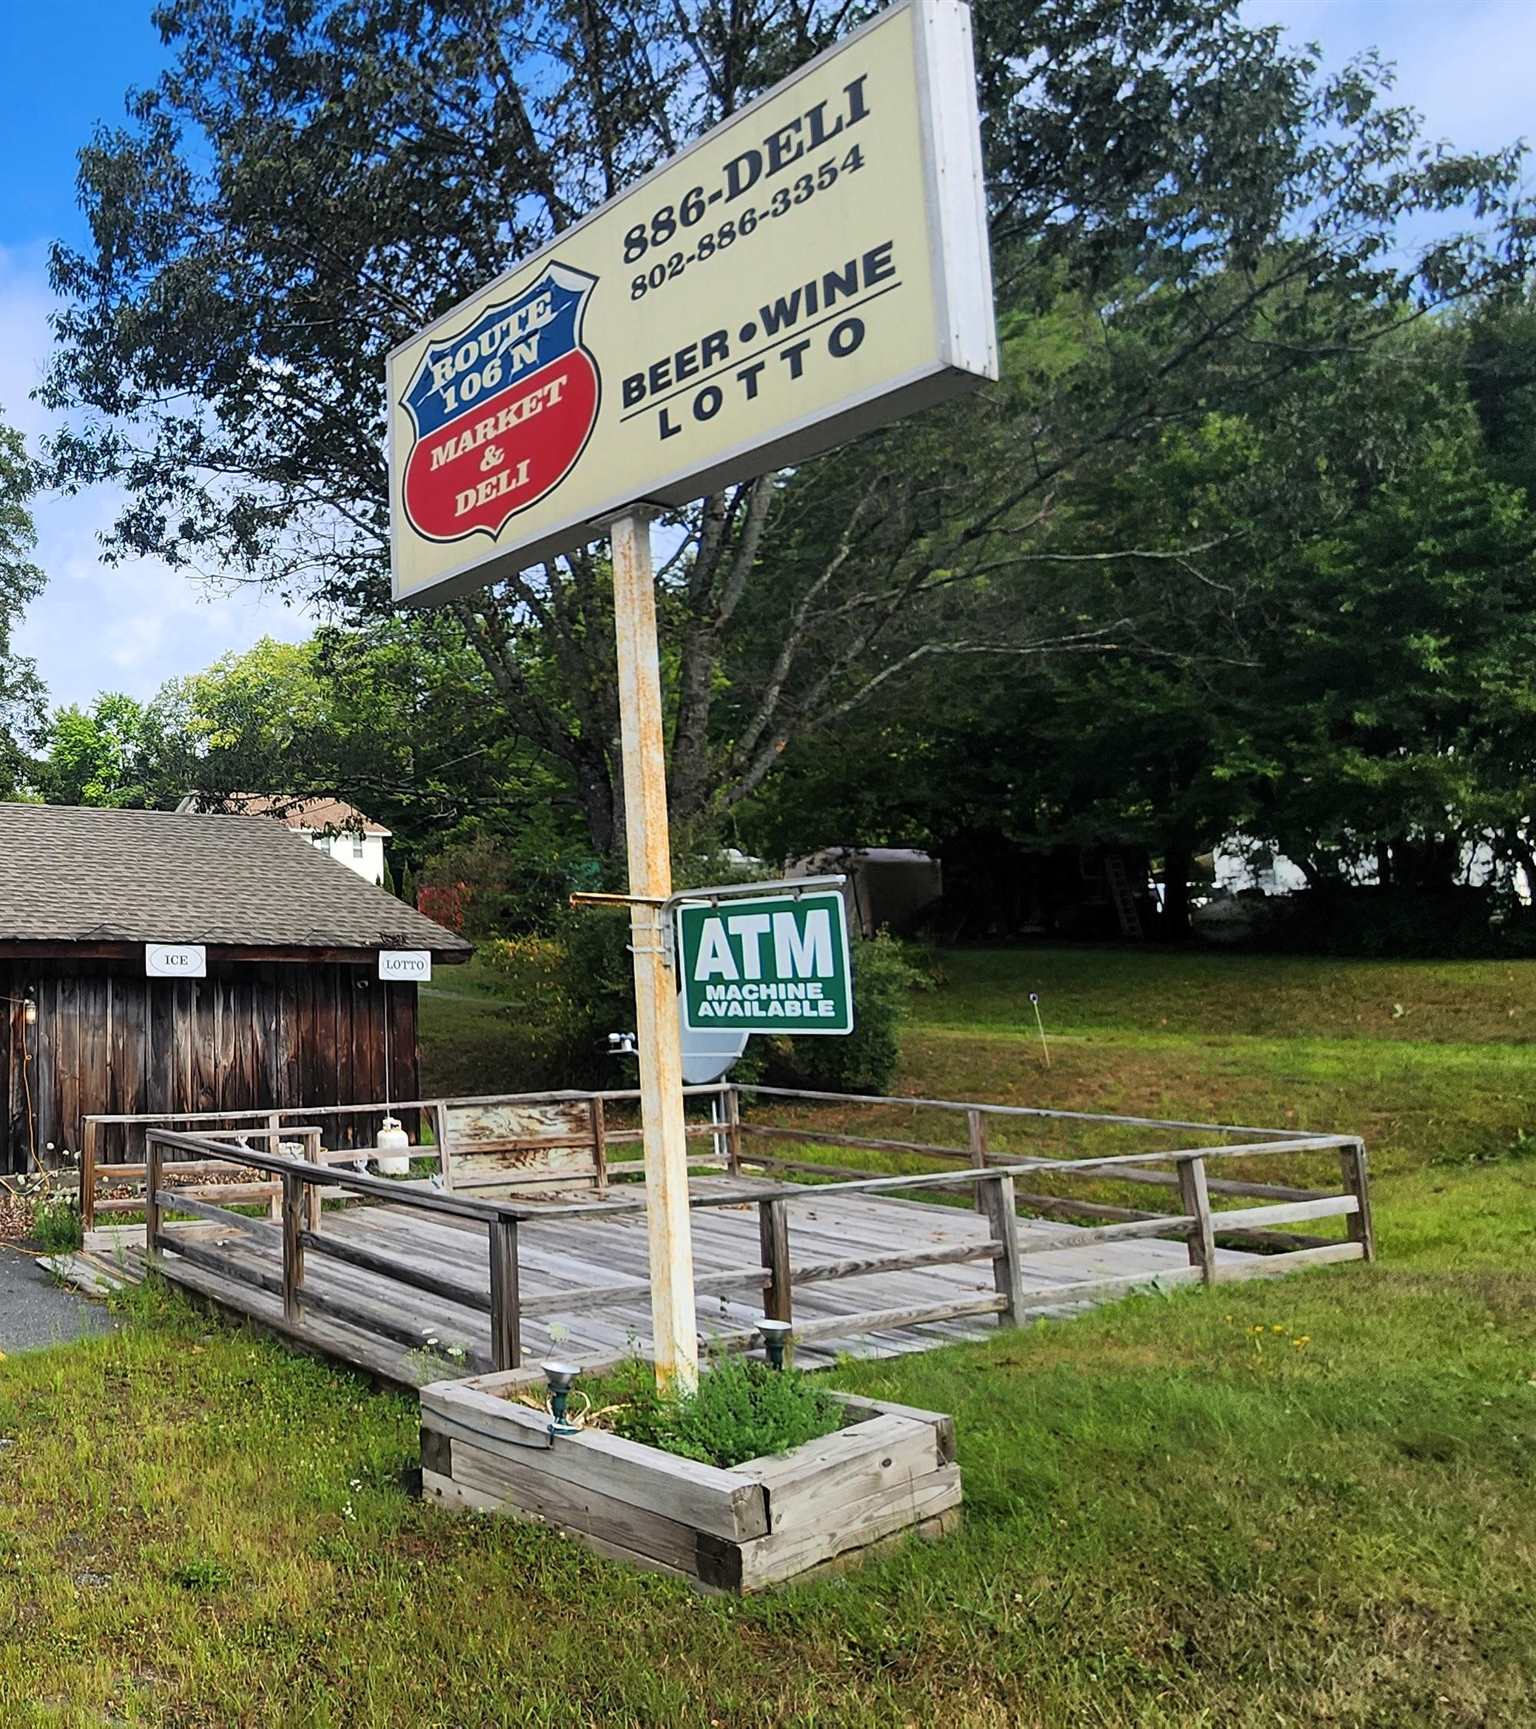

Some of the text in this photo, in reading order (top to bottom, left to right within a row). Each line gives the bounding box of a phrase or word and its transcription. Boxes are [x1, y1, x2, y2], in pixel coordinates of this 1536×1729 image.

[623, 73, 871, 264] 886-DELI
[630, 143, 865, 301] 802-886-3354
[430, 291, 552, 391] ROUTE
[622, 240, 897, 409] BEER WINE
[442, 332, 541, 414] 106 N
[659, 317, 865, 441] LOTTO
[430, 375, 568, 471] MARKET
[480, 444, 505, 472] &
[454, 459, 531, 517] DELI
[165, 955, 188, 965] ICE
[386, 960, 424, 970] LOTTO
[694, 909, 834, 981] ATM
[697, 999, 835, 1018] AVAILABLE
[705, 982, 824, 1001] MACHINE
